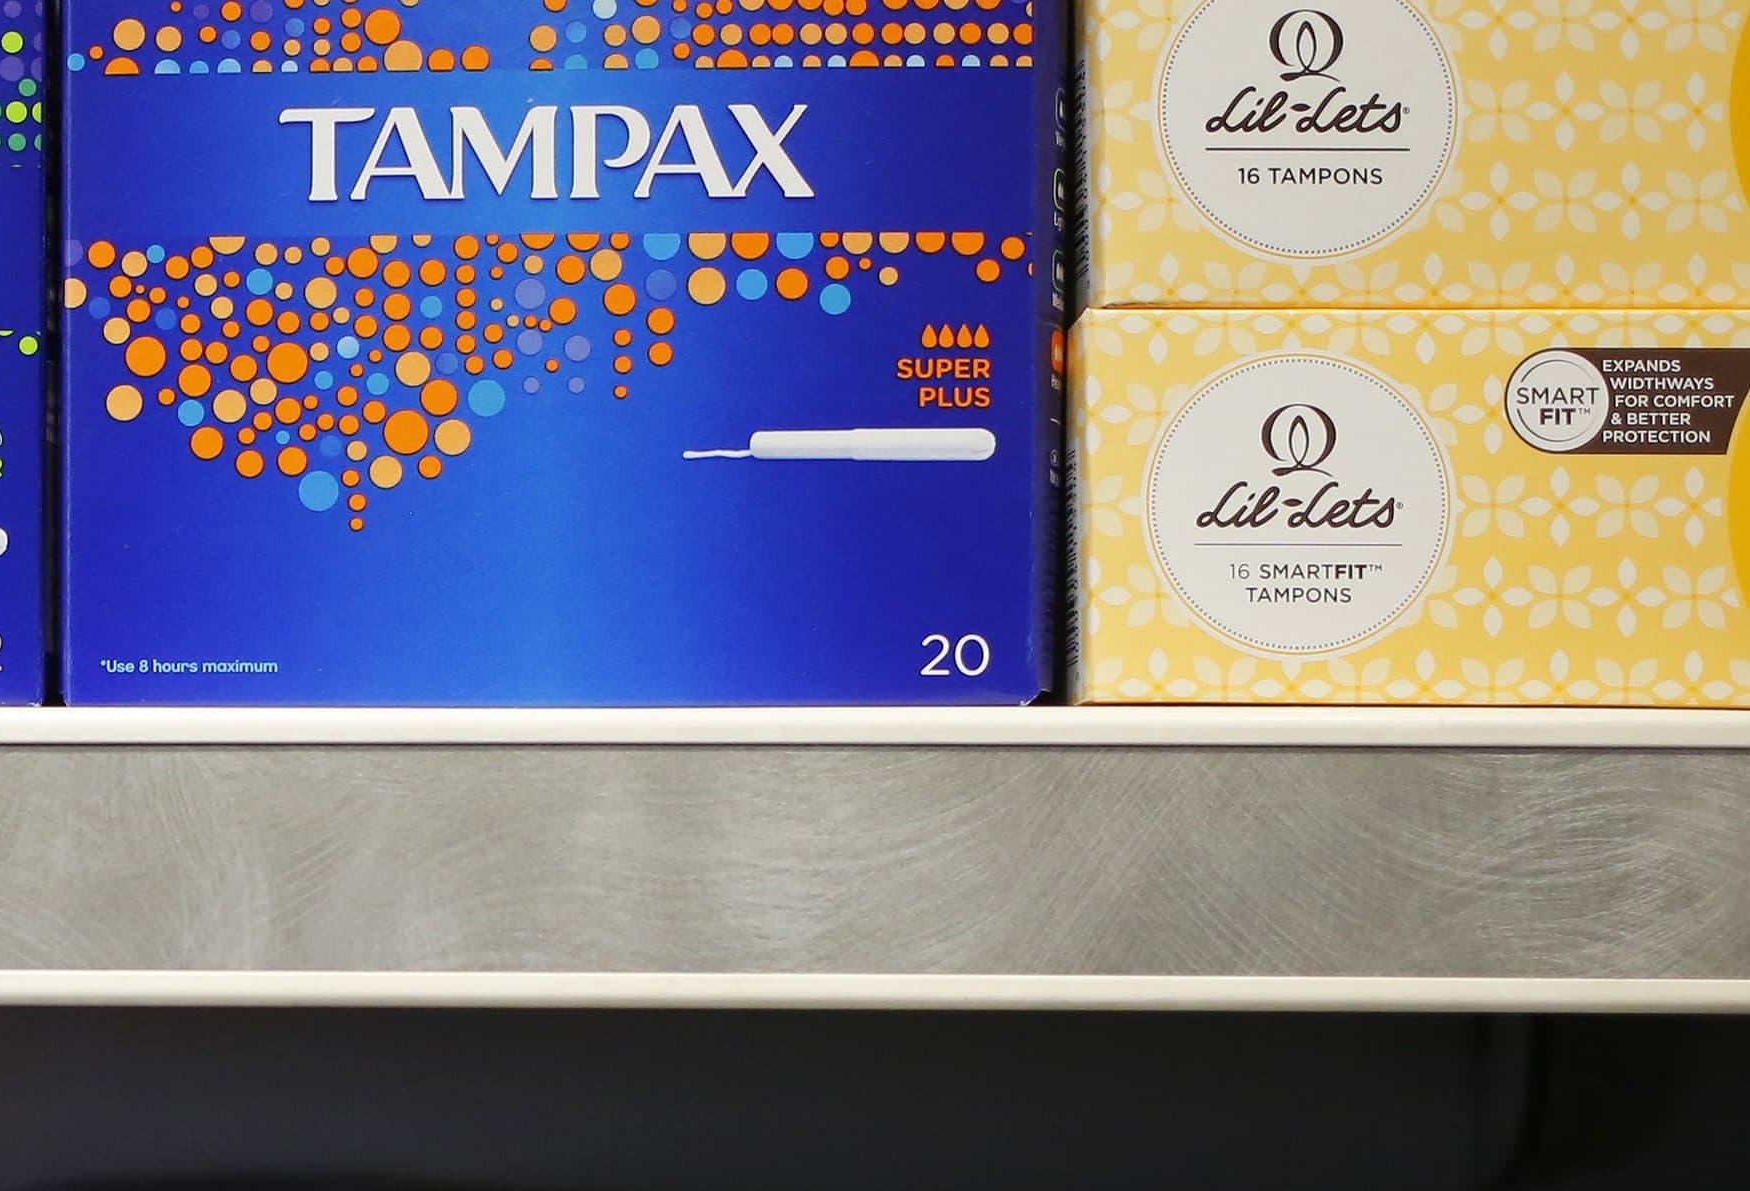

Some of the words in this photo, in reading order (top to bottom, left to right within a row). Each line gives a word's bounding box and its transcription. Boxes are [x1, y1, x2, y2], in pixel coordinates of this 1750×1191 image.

[278, 103, 815, 202] TAMPAX
[1237, 167, 1260, 185] 16
[1268, 167, 1384, 186] TAMPONS
[896, 358, 991, 379] SUPER
[1602, 359, 1681, 374] EXPANDS
[1609, 376, 1715, 391] WIDTHWAYS
[918, 386, 991, 408] PLUS
[1515, 385, 1599, 406] SMART
[1615, 394, 1649, 409] FOR
[1653, 394, 1735, 409] COMFORT
[1611, 412, 1622, 426] &
[1626, 412, 1692, 427] BETTER
[1602, 429, 1711, 445] PROTECTION
[1228, 563, 1251, 580] 16
[1245, 586, 1352, 604] TAMPONS
[920, 634, 990, 676] 20
[139, 659, 149, 673] 8
[153, 659, 198, 673] hours
[202, 659, 278, 673] maximum
